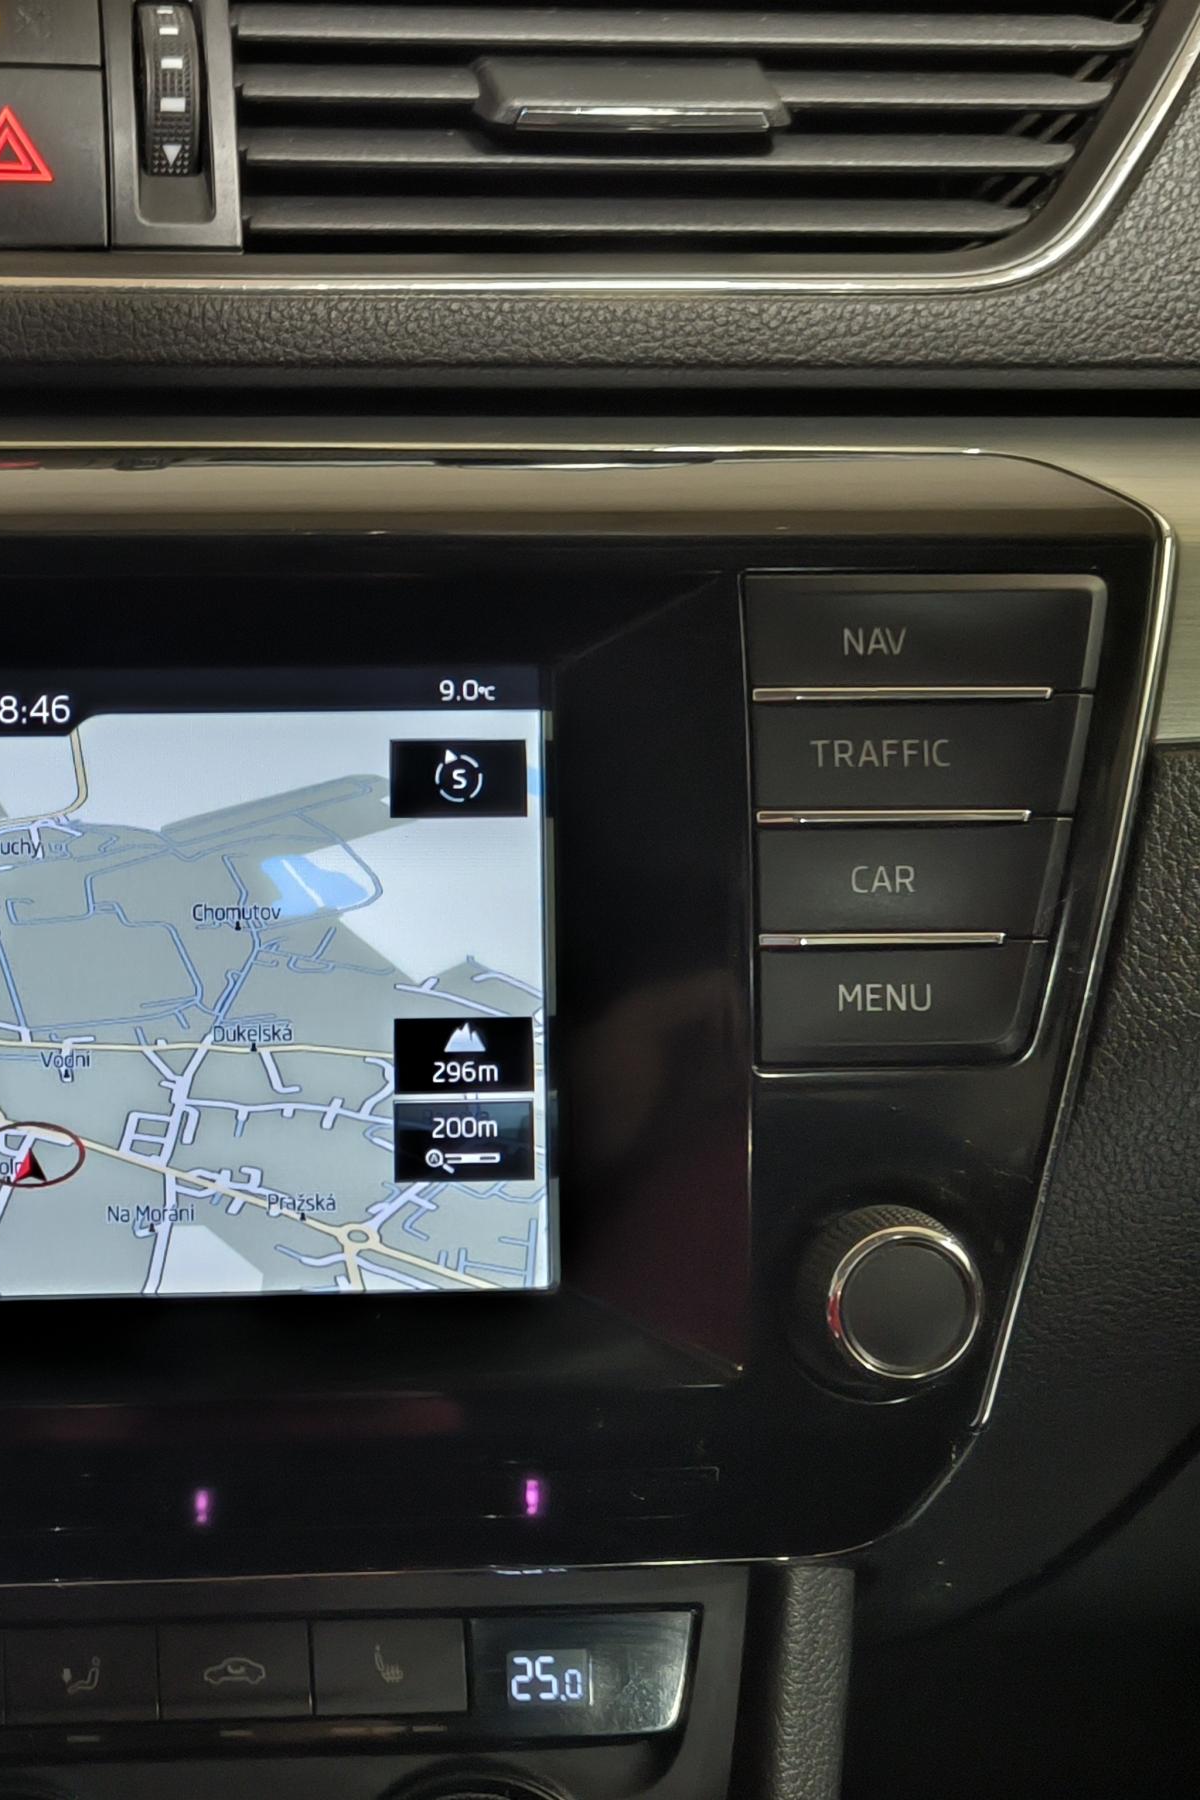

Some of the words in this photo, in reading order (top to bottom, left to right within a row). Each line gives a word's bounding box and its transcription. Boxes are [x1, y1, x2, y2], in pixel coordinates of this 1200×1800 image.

[842, 627, 907, 656] NAV
[810, 738, 952, 768] TRAFFIC
[851, 864, 916, 894] CAR
[193, 902, 282, 924] Chomutov
[837, 983, 933, 1013] MENU
[213, 1023, 293, 1044] Dukelská
[432, 1060, 499, 1084] 296m
[431, 1116, 498, 1140] 200m
[107, 1204, 131, 1224] Na
[267, 1191, 337, 1213] Pražská
[511, 1655, 583, 1702] 25.0
